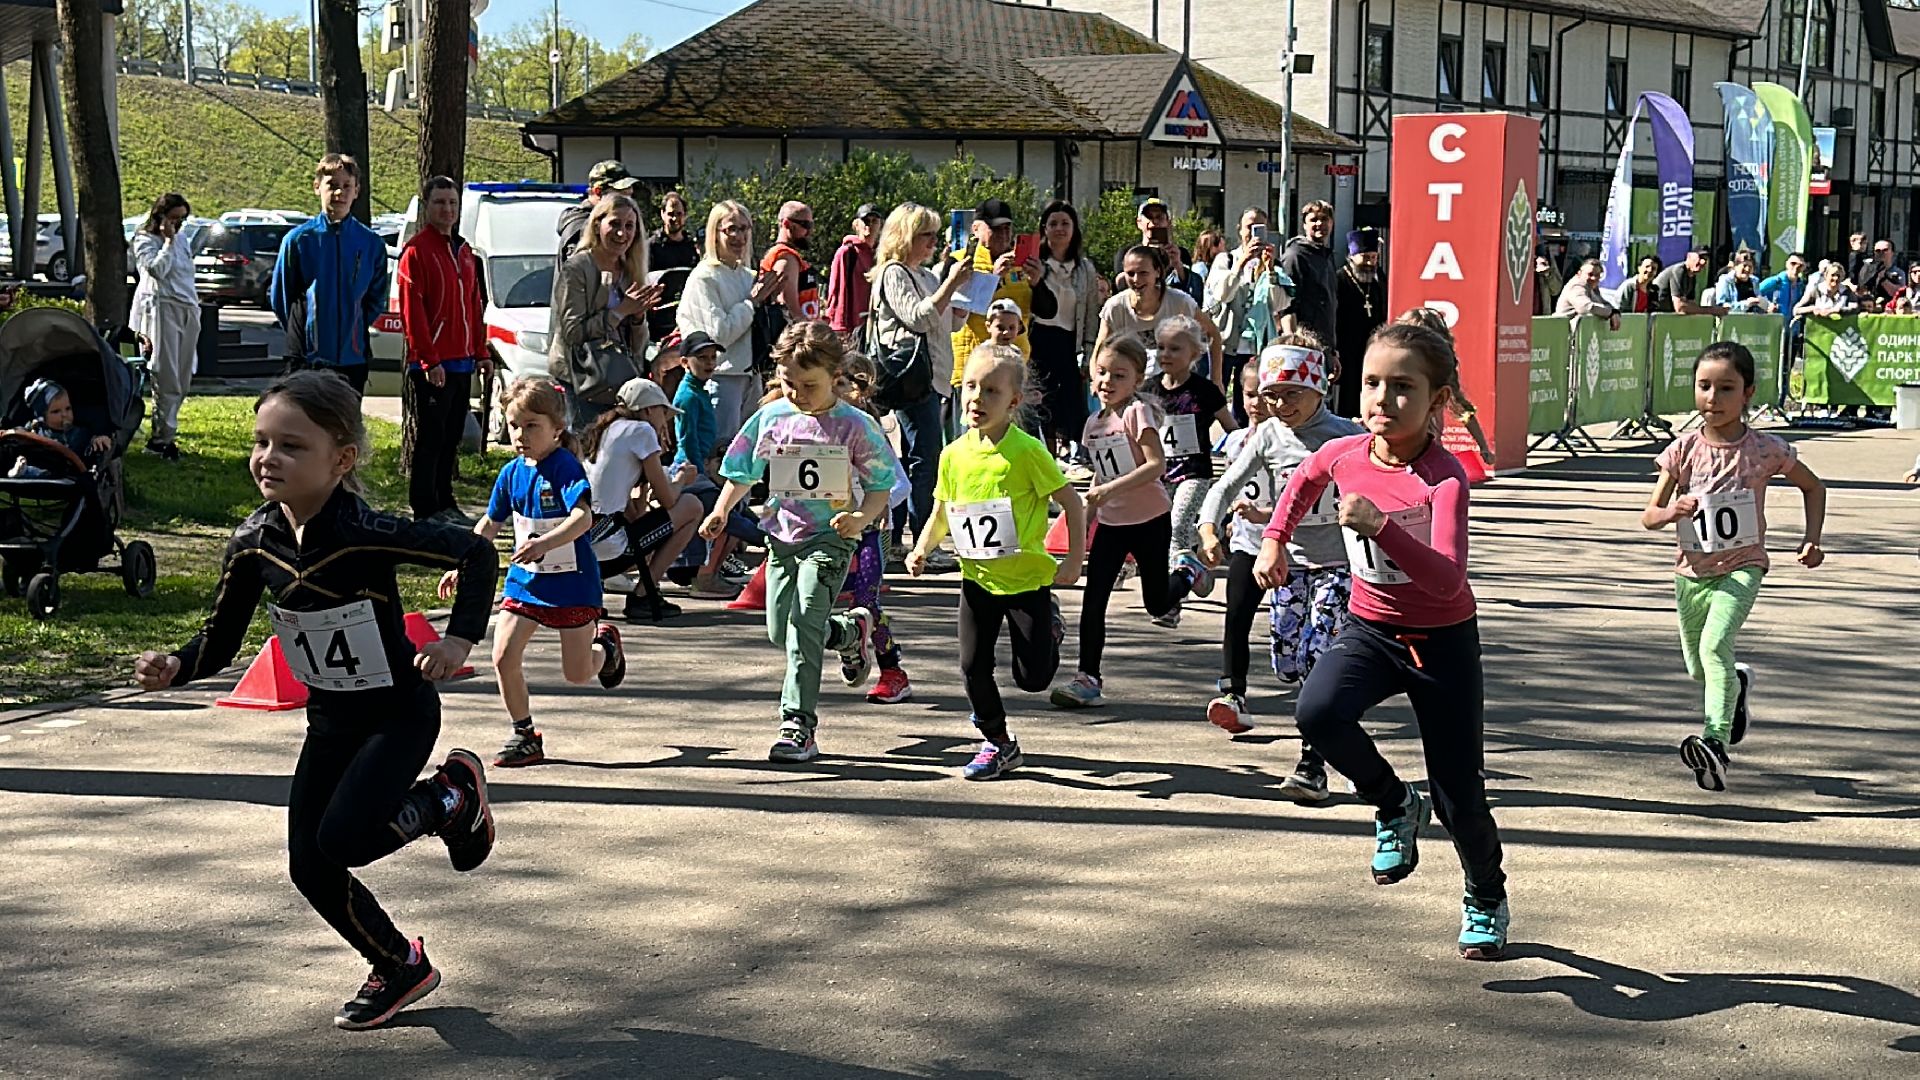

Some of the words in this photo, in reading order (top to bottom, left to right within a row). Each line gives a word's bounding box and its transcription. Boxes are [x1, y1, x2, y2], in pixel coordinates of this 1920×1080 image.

[1173, 156, 1222, 171] МАГАЗИН
[1877, 350, 1912, 363] ПАРК
[1164, 426, 1178, 449] 4
[798, 458, 820, 491] 6
[1096, 447, 1120, 477] 11
[962, 515, 1002, 549] 12
[1692, 507, 1739, 541] 10
[293, 629, 361, 676] 14
